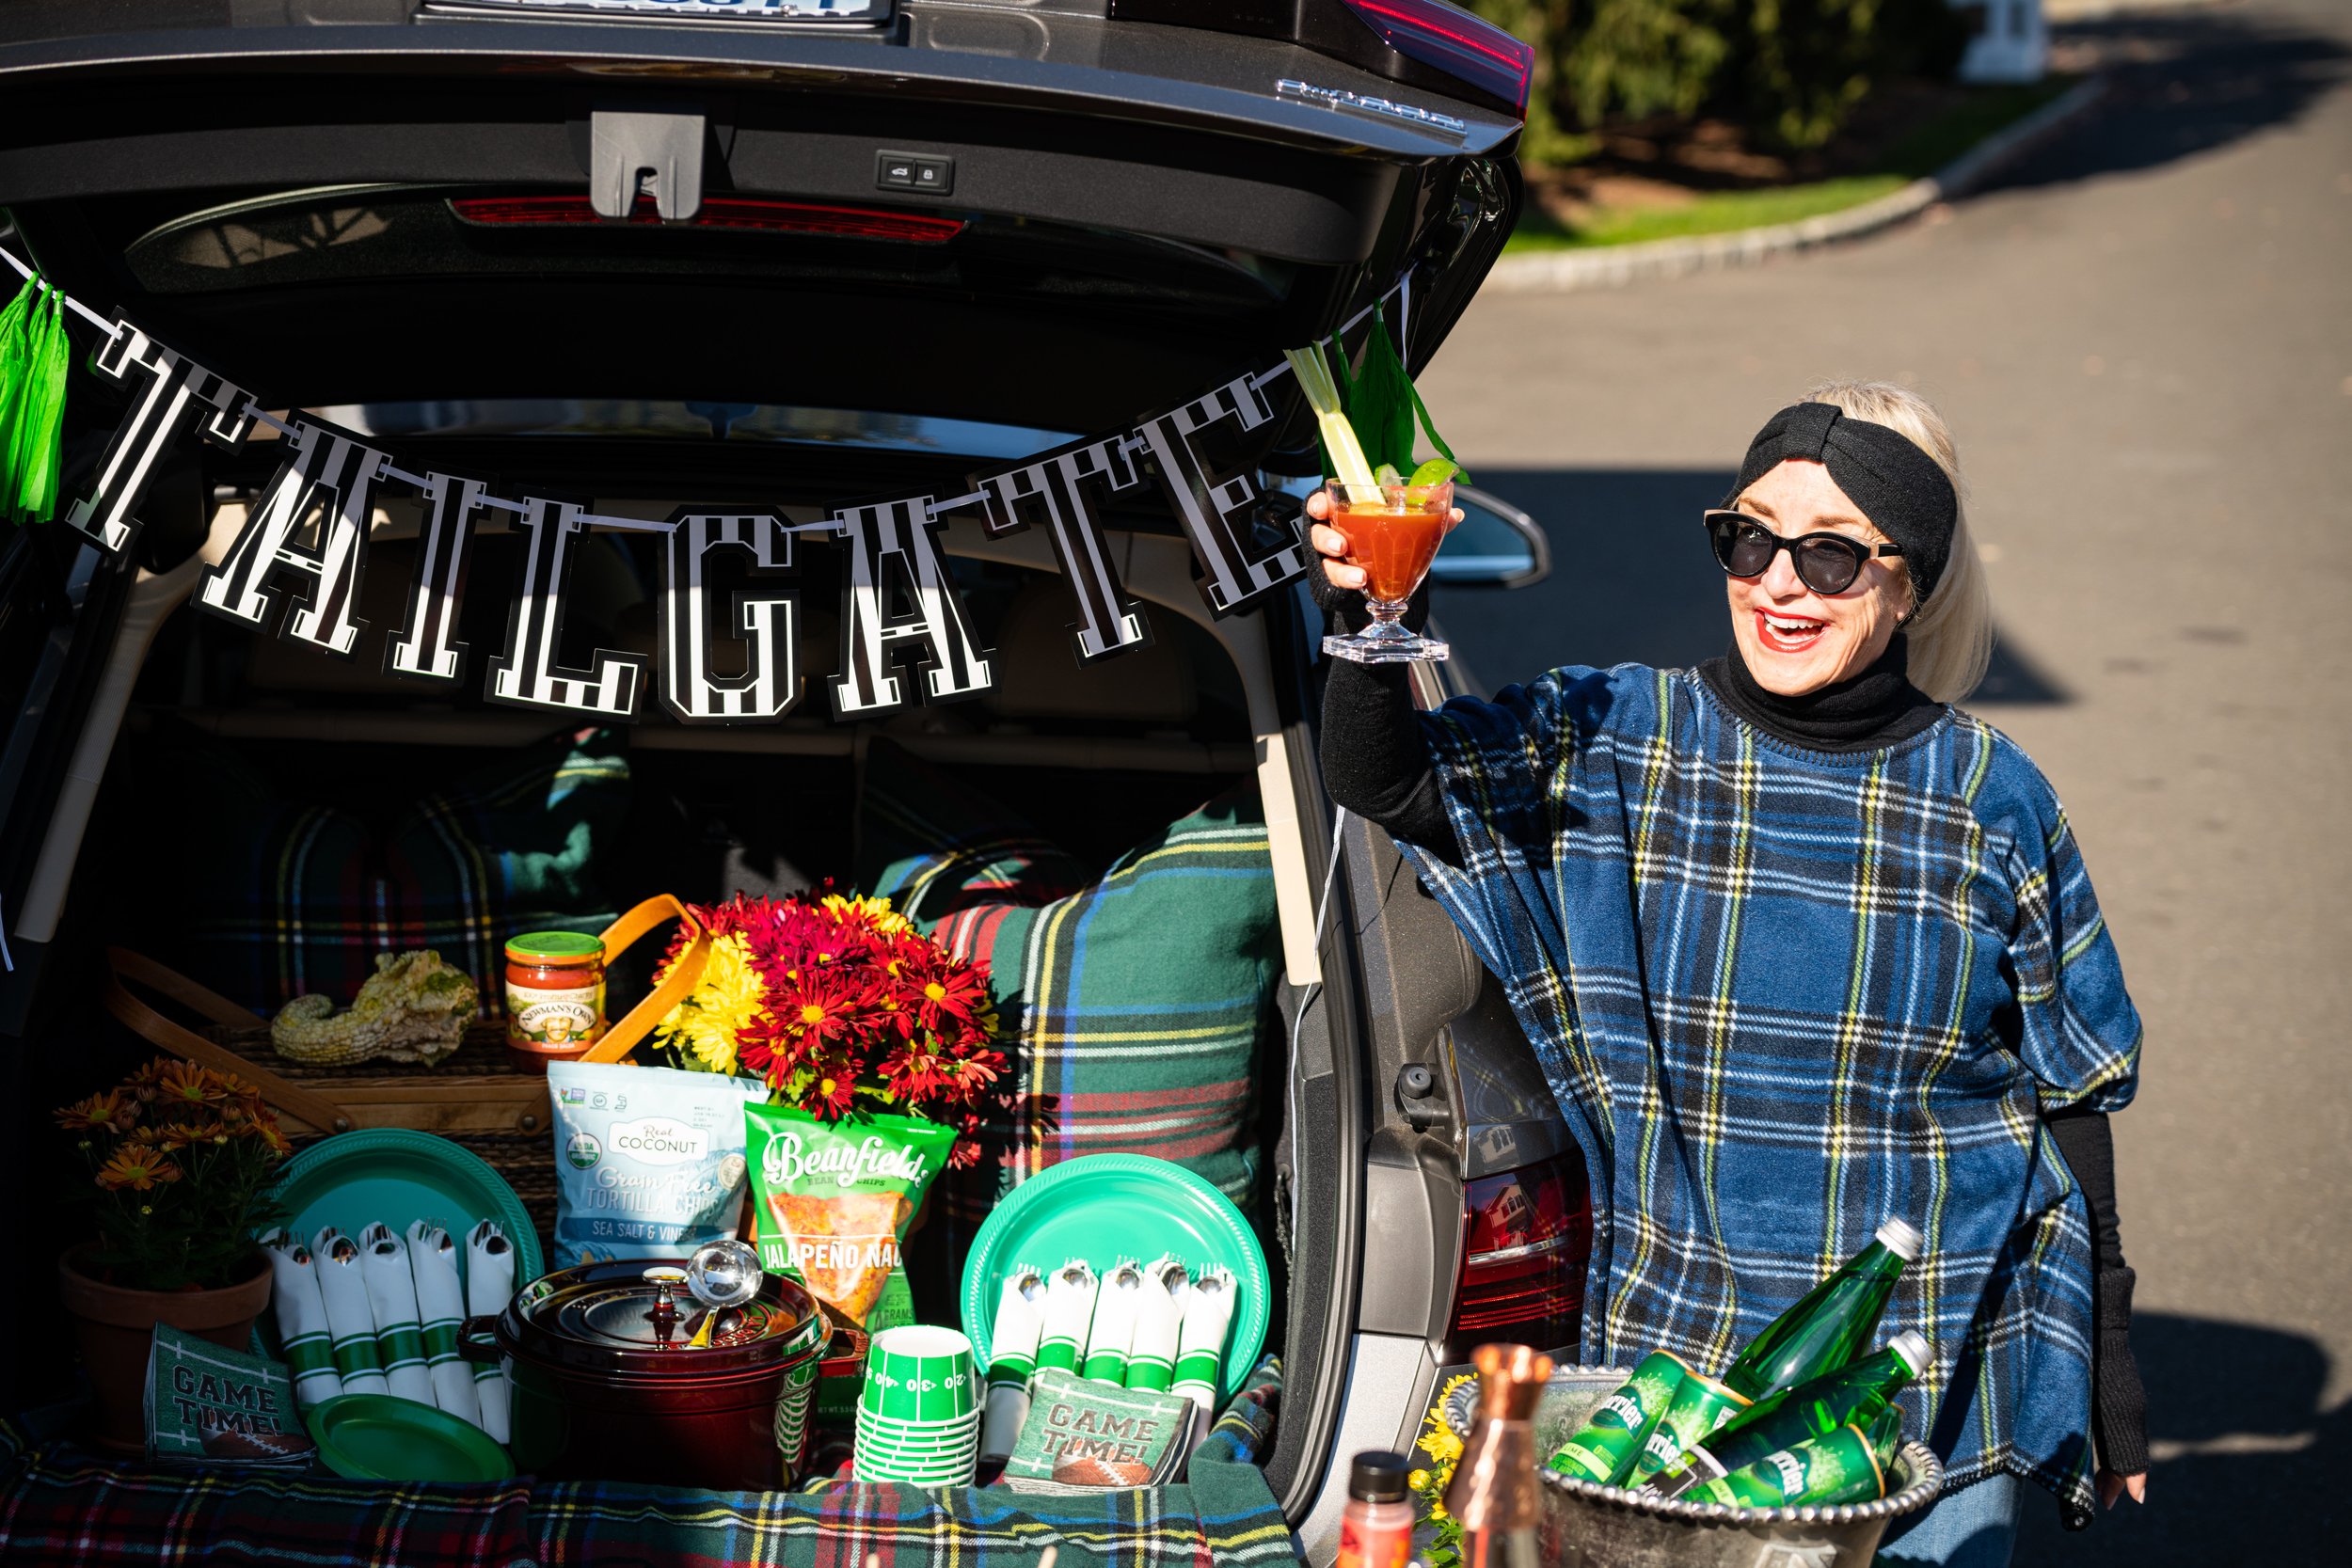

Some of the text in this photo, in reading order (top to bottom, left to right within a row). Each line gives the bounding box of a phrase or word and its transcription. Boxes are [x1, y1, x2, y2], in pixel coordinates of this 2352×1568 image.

[65, 316, 1306, 715] TAILGATE
[643, 1123, 675, 1138] Real
[617, 1136, 697, 1155] COCONUT
[596, 1166, 662, 1190] Grain
[587, 1187, 665, 1214] TORTILLA
[592, 1220, 613, 1236] SEA
[617, 1223, 644, 1239] SALT
[647, 1225, 656, 1240] &
[764, 1239, 902, 1269] JALAPEÑO NAC
[172, 1364, 279, 1415] GAME
[172, 1395, 285, 1437] TIME!
[1046, 1402, 1160, 1442] GAME
[1042, 1428, 1149, 1465] TIME!
[1563, 1445, 1584, 1457] LIME
